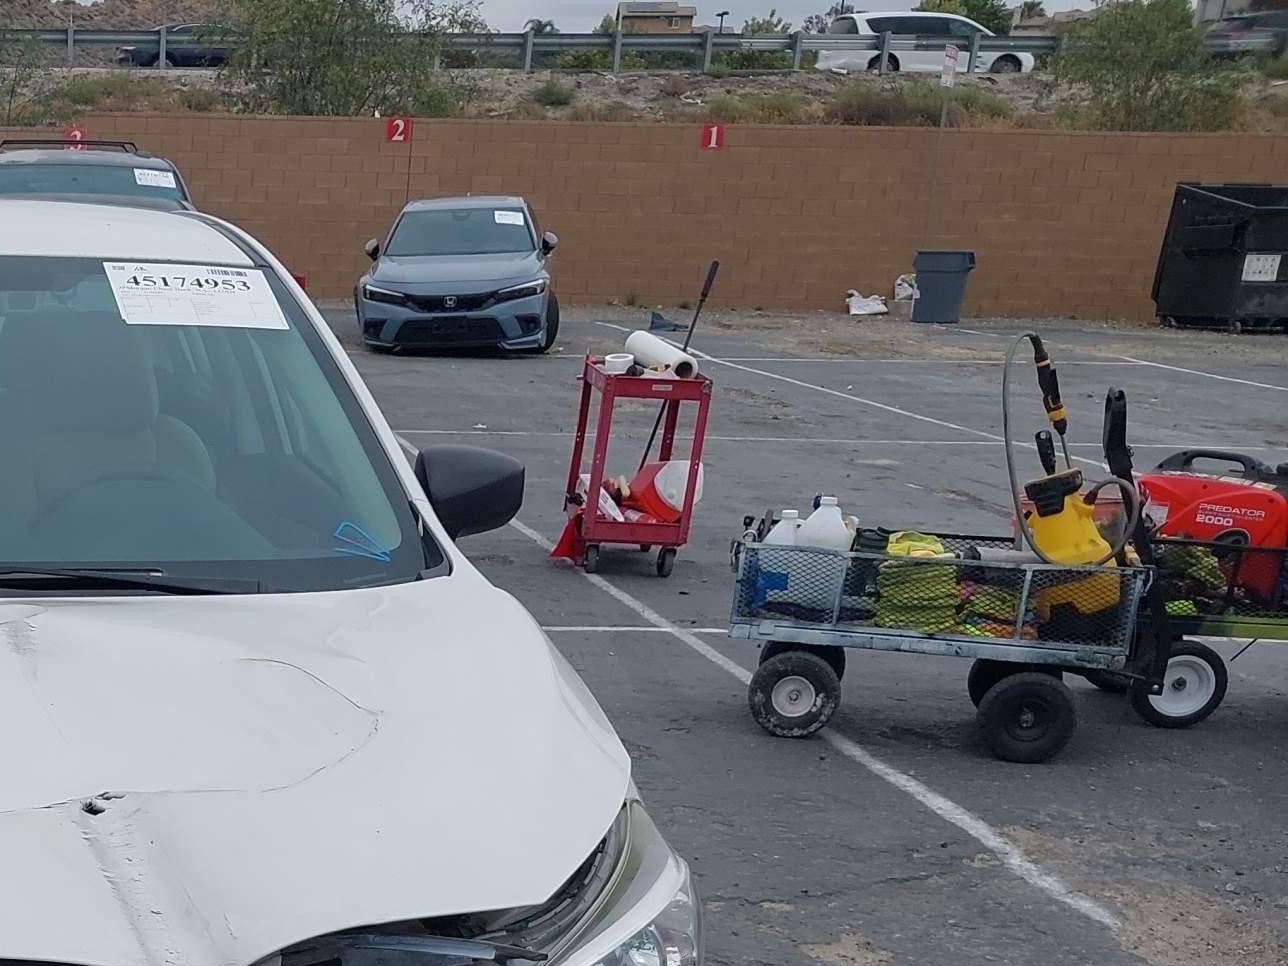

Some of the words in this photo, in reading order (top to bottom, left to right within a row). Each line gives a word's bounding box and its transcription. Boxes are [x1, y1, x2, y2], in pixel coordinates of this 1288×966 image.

[391, 119, 405, 141] 2
[708, 125, 718, 148] 1
[126, 275, 251, 292] 45174953
[1199, 502, 1266, 518] PREDATOR
[1196, 513, 1234, 527] 2000
